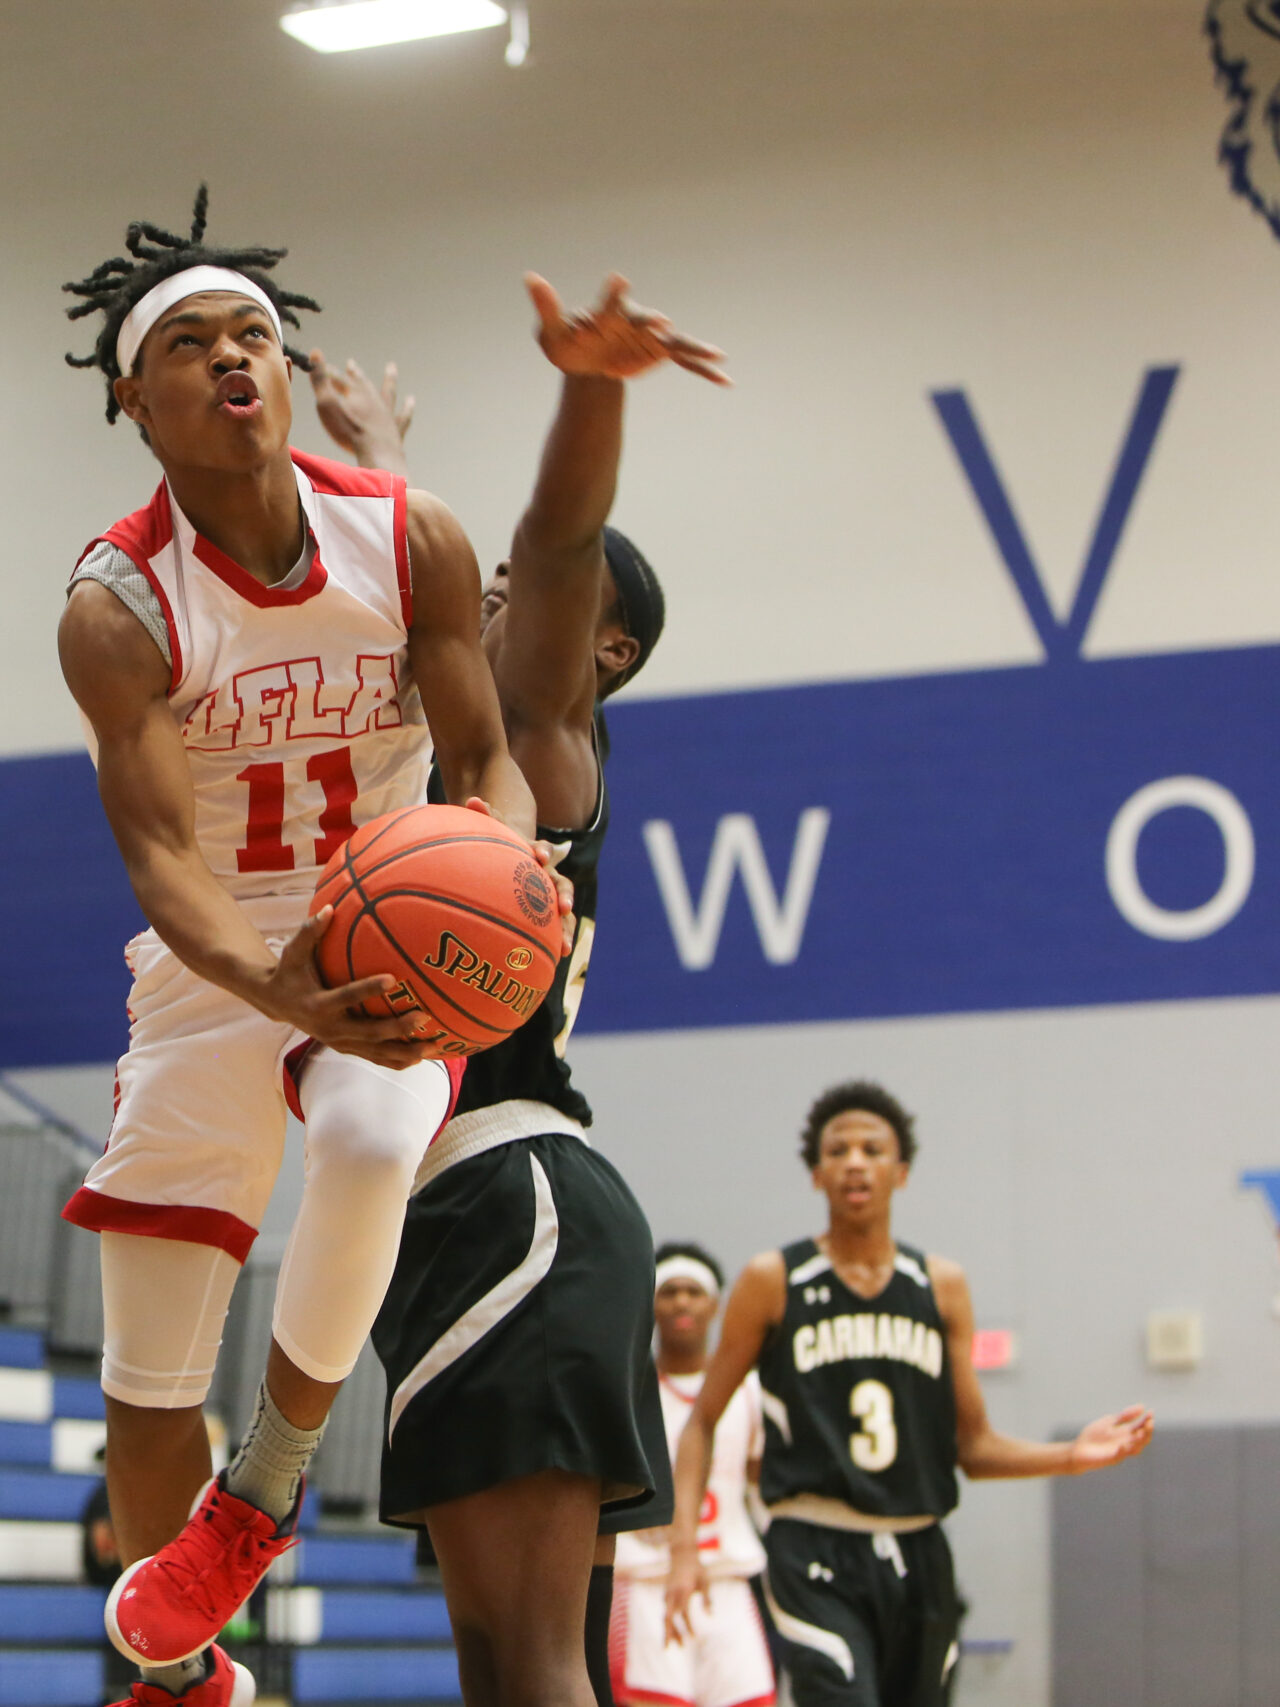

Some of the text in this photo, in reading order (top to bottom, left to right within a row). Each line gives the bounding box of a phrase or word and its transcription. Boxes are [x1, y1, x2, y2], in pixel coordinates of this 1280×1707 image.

[235, 746, 358, 873] 11
[424, 930, 546, 1020] SPALDIN
[849, 1378, 898, 1472] 3
